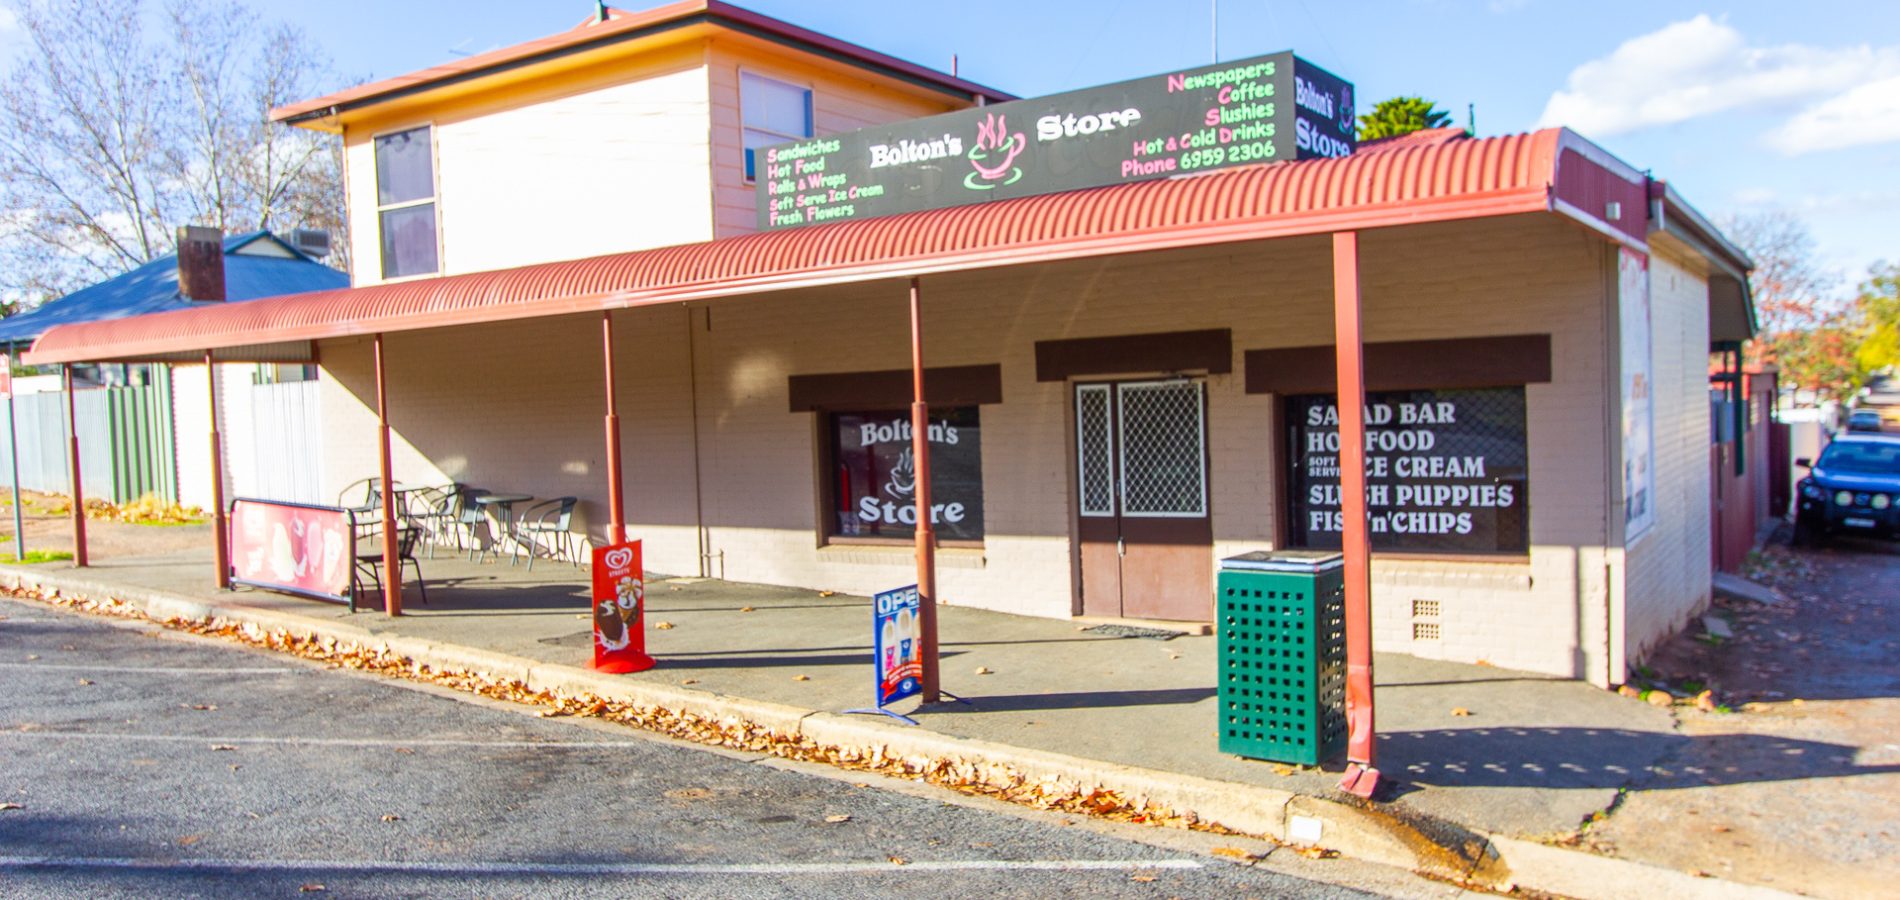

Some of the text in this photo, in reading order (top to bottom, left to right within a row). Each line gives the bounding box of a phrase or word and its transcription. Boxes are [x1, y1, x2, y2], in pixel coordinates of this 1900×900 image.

[1168, 61, 1275, 93] Newspapers
[1218, 81, 1275, 104] Coffee
[1295, 76, 1333, 120] Bolton's
[1205, 102, 1275, 126] Slushies
[869, 107, 1141, 168] Bolton's Store
[1133, 121, 1275, 157] Hot & Cold Drinks
[1295, 117, 1350, 159] Store
[768, 139, 840, 163] Sandwiches
[1121, 140, 1276, 177] Phone 6959 2306
[768, 156, 825, 179] Hot Food
[768, 179, 796, 195] Rolls
[808, 173, 847, 189] Wraps
[770, 184, 884, 211] Soft Serve Ice Cream
[770, 204, 854, 226] Fresh Flowers
[1307, 402, 1456, 426] SAAD BAR
[860, 419, 959, 447] Boltn's
[1307, 430, 1435, 452] HO FOOD
[1308, 456, 1336, 466] SOFT
[1394, 456, 1486, 478] CREAM
[1309, 484, 1514, 507] SLH PUPPIES
[858, 496, 965, 525] Store
[877, 588, 920, 615] OPE
